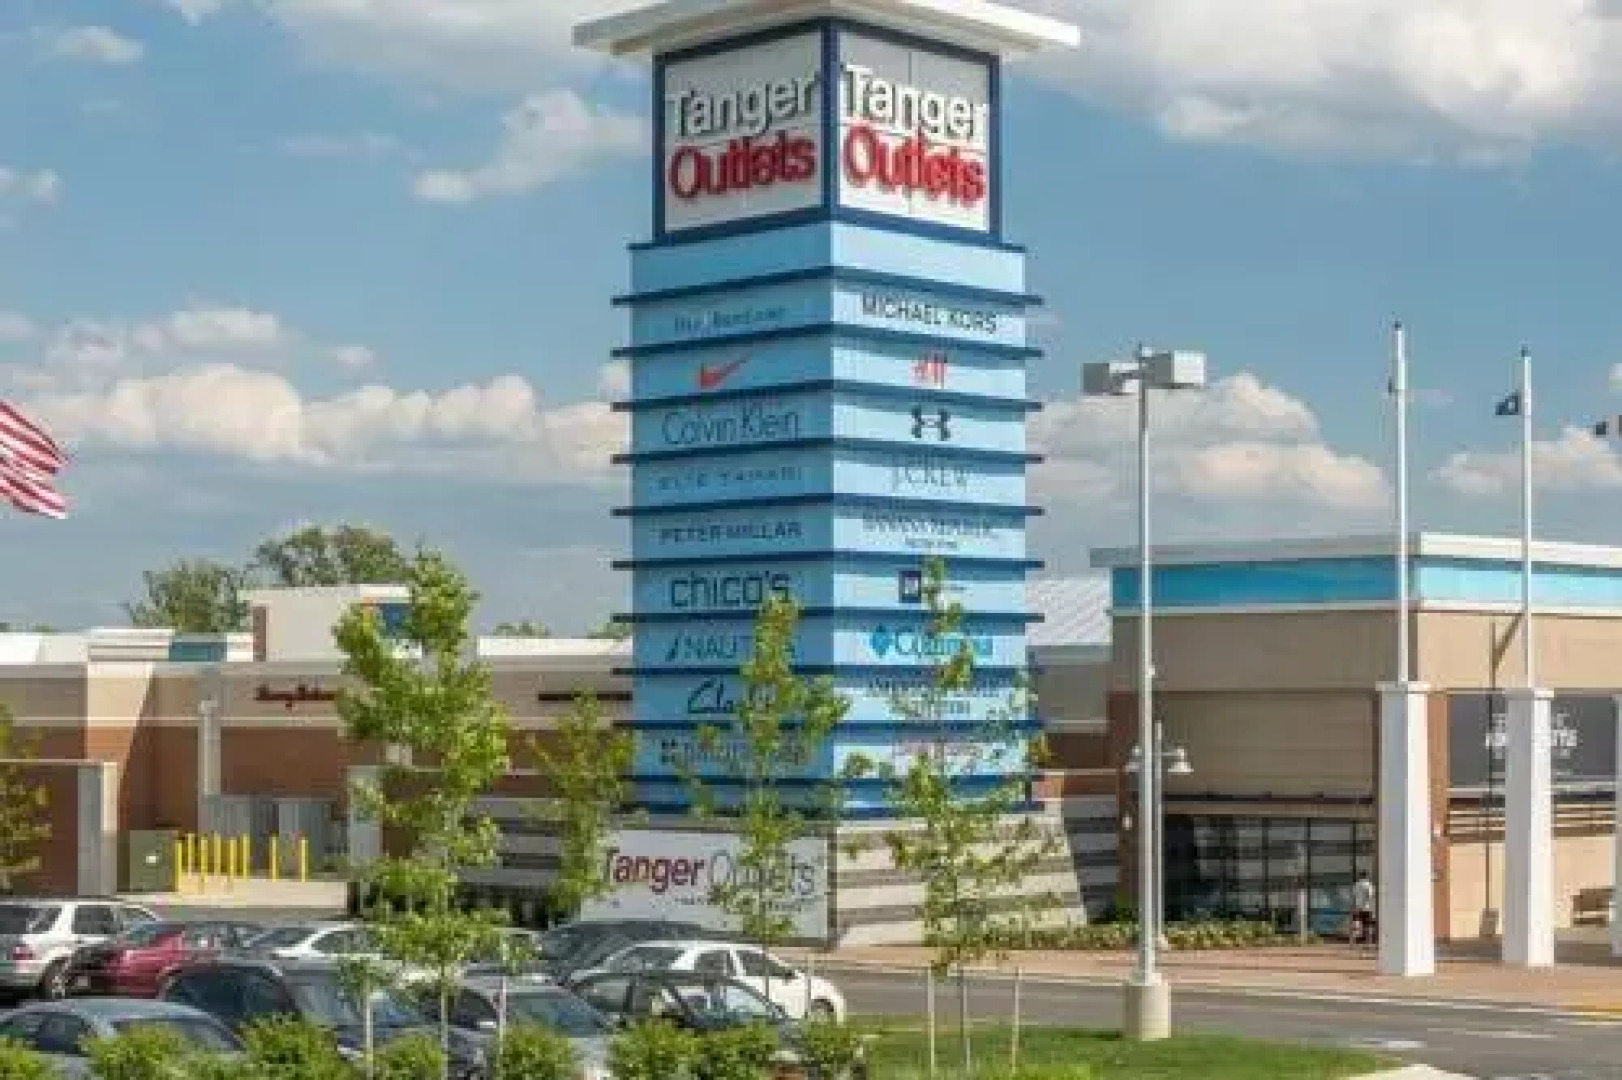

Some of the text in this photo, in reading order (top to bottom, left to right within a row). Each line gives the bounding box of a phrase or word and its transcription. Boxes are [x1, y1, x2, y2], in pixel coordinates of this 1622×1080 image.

[669, 72, 820, 137] Tanger
[841, 63, 988, 141] Tanger
[669, 129, 819, 199] Outlets
[842, 125, 985, 207] Outlets
[862, 290, 998, 334] MICHAEL KORS
[661, 401, 799, 445] Calvin Klein
[660, 526, 721, 545] PETER
